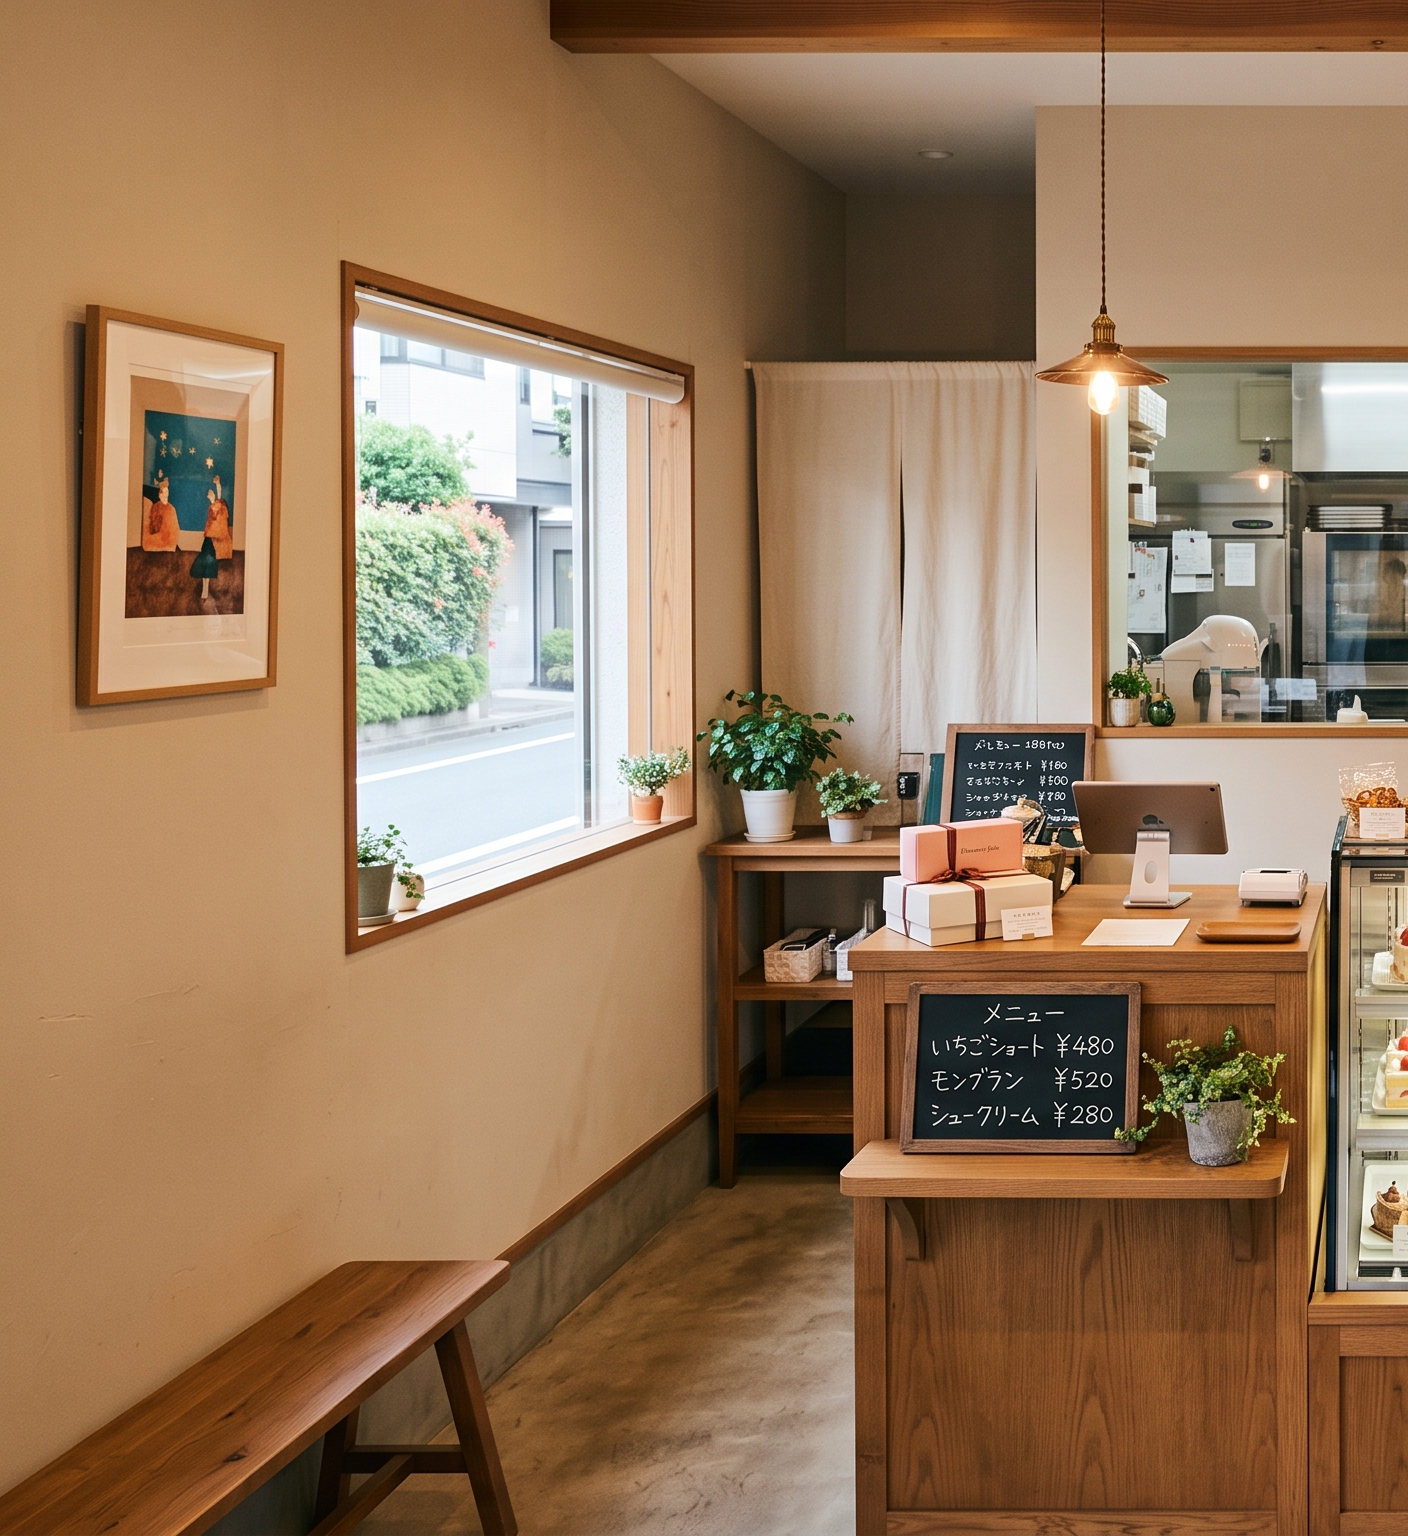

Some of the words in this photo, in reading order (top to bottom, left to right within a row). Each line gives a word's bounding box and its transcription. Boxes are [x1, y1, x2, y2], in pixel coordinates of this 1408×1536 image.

[983, 1003, 1065, 1024] メニュー
[931, 1033, 1044, 1058] いちごショート
[1056, 1033, 1115, 1058] ¥480
[931, 1066, 1025, 1092] モンブラン
[1053, 1067, 1113, 1092] ¥520
[931, 1103, 1040, 1127] シュークリーム
[1053, 1101, 1113, 1128] ¥280
